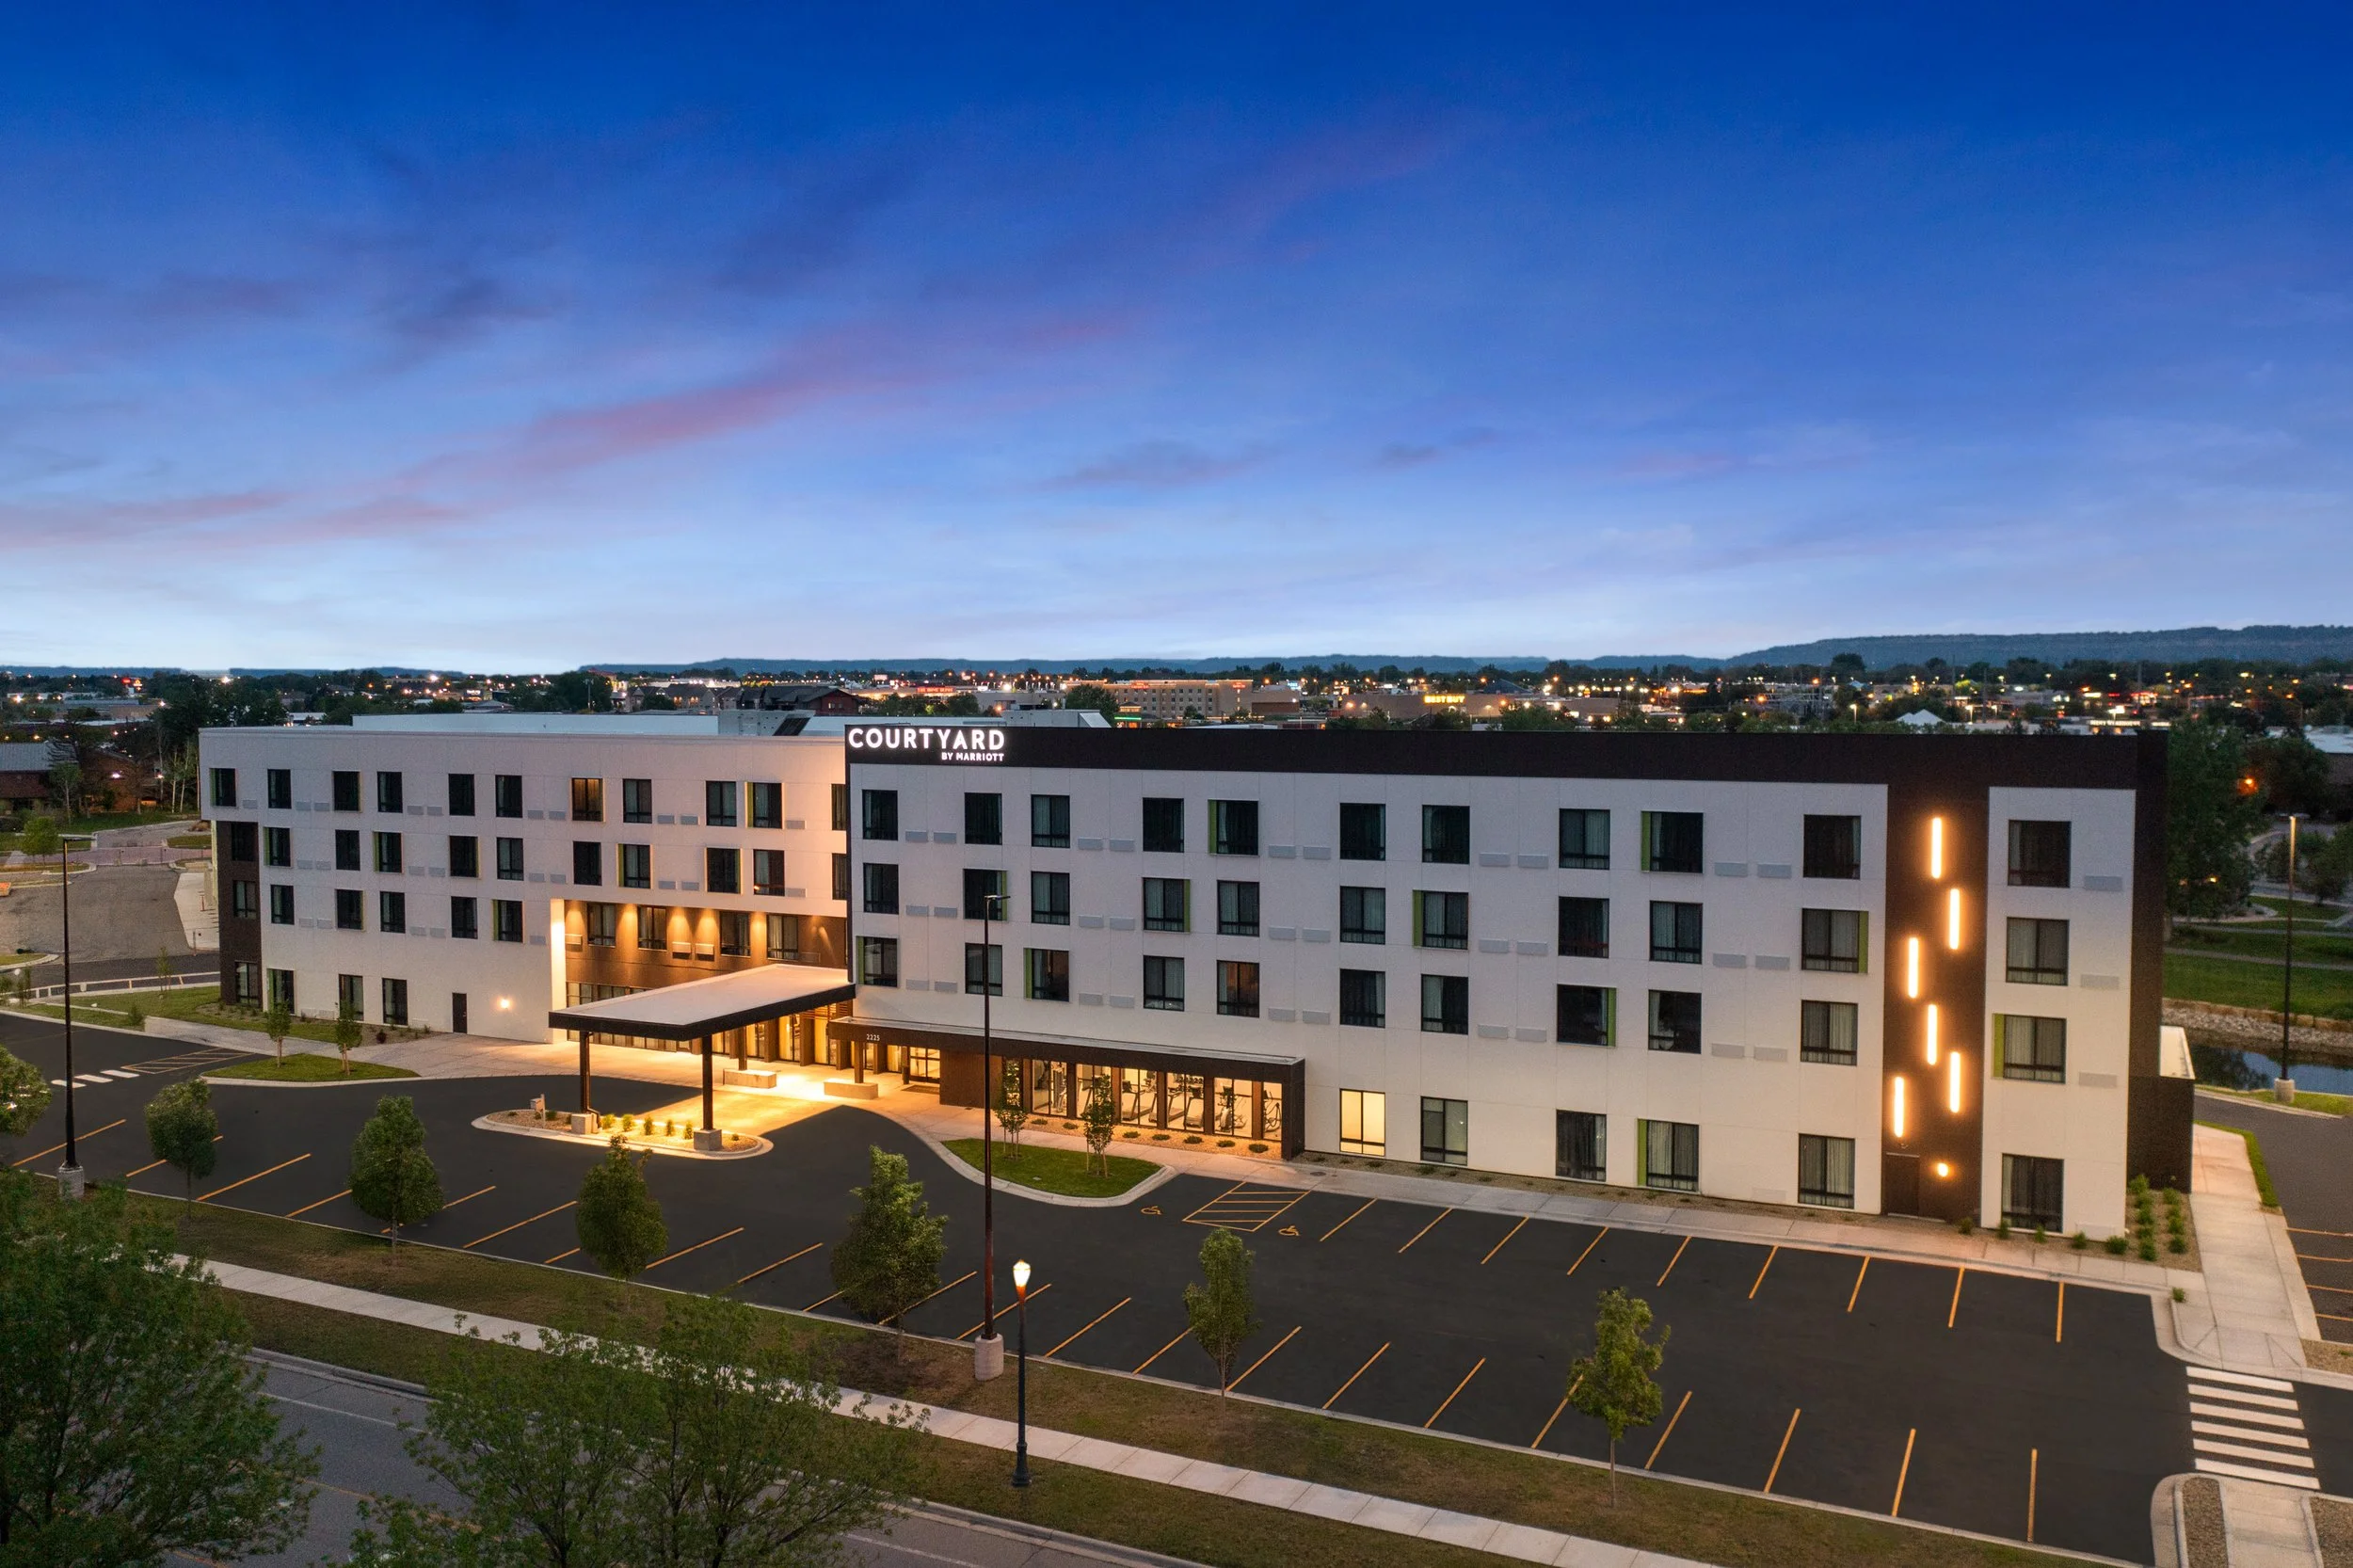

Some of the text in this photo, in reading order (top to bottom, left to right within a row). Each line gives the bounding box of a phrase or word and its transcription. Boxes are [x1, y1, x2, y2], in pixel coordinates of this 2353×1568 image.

[848, 728, 1004, 750] COURTYARD
[942, 752, 1004, 761] BY MARRIOTT
